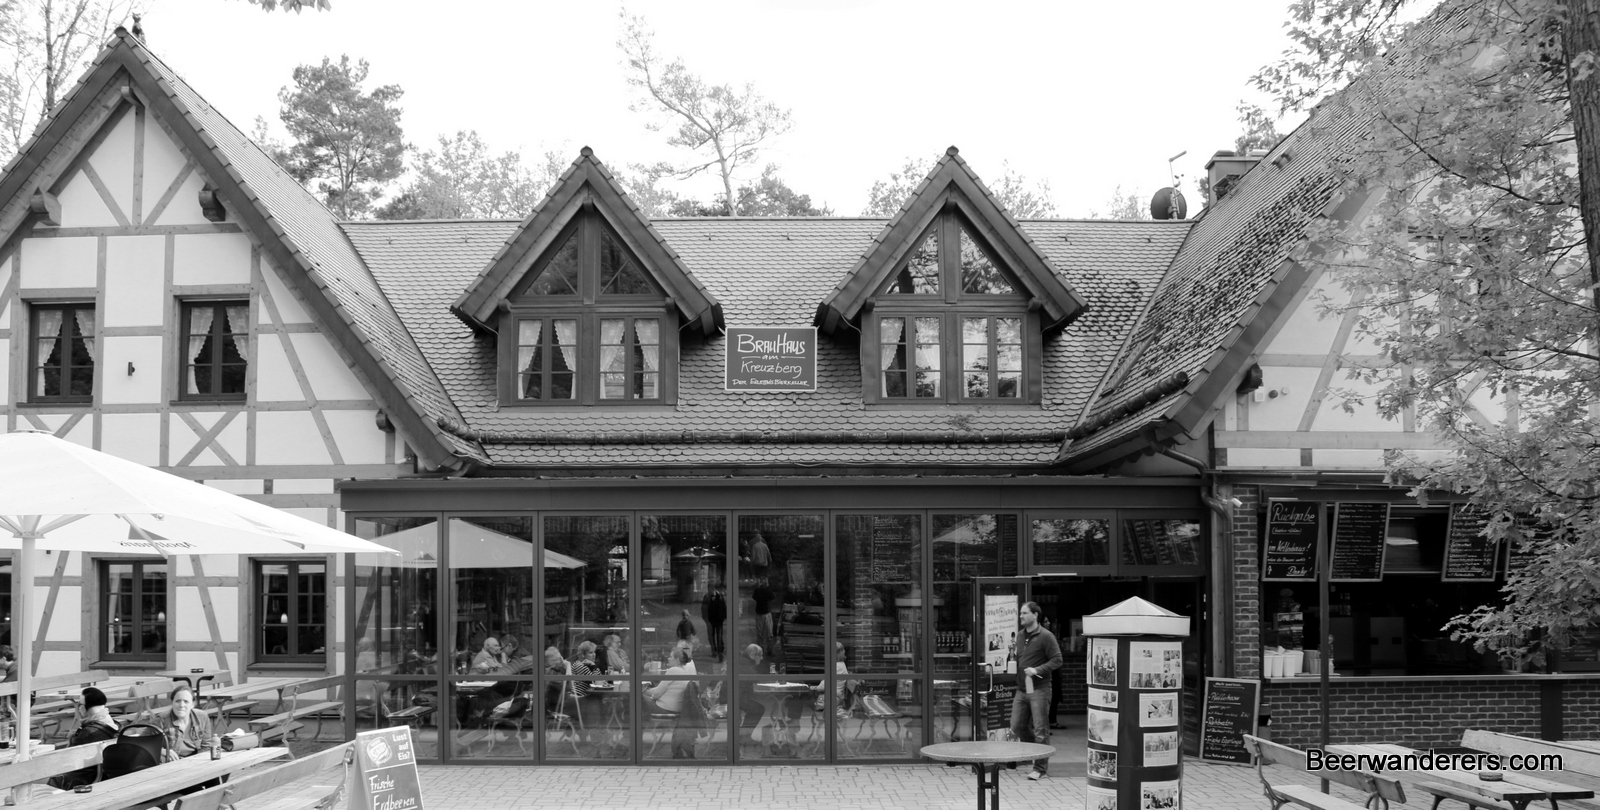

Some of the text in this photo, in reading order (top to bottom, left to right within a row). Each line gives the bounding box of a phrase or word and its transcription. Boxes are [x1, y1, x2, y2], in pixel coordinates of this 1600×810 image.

[741, 360, 802, 379] Kreuzberg
[1272, 503, 1315, 526] Rückgabe
[392, 733, 407, 742] Lust
[398, 742, 409, 750] auf
[397, 752, 411, 761] Eis?
[368, 774, 395, 791] Frische
[373, 794, 415, 810] Erdbeeren
